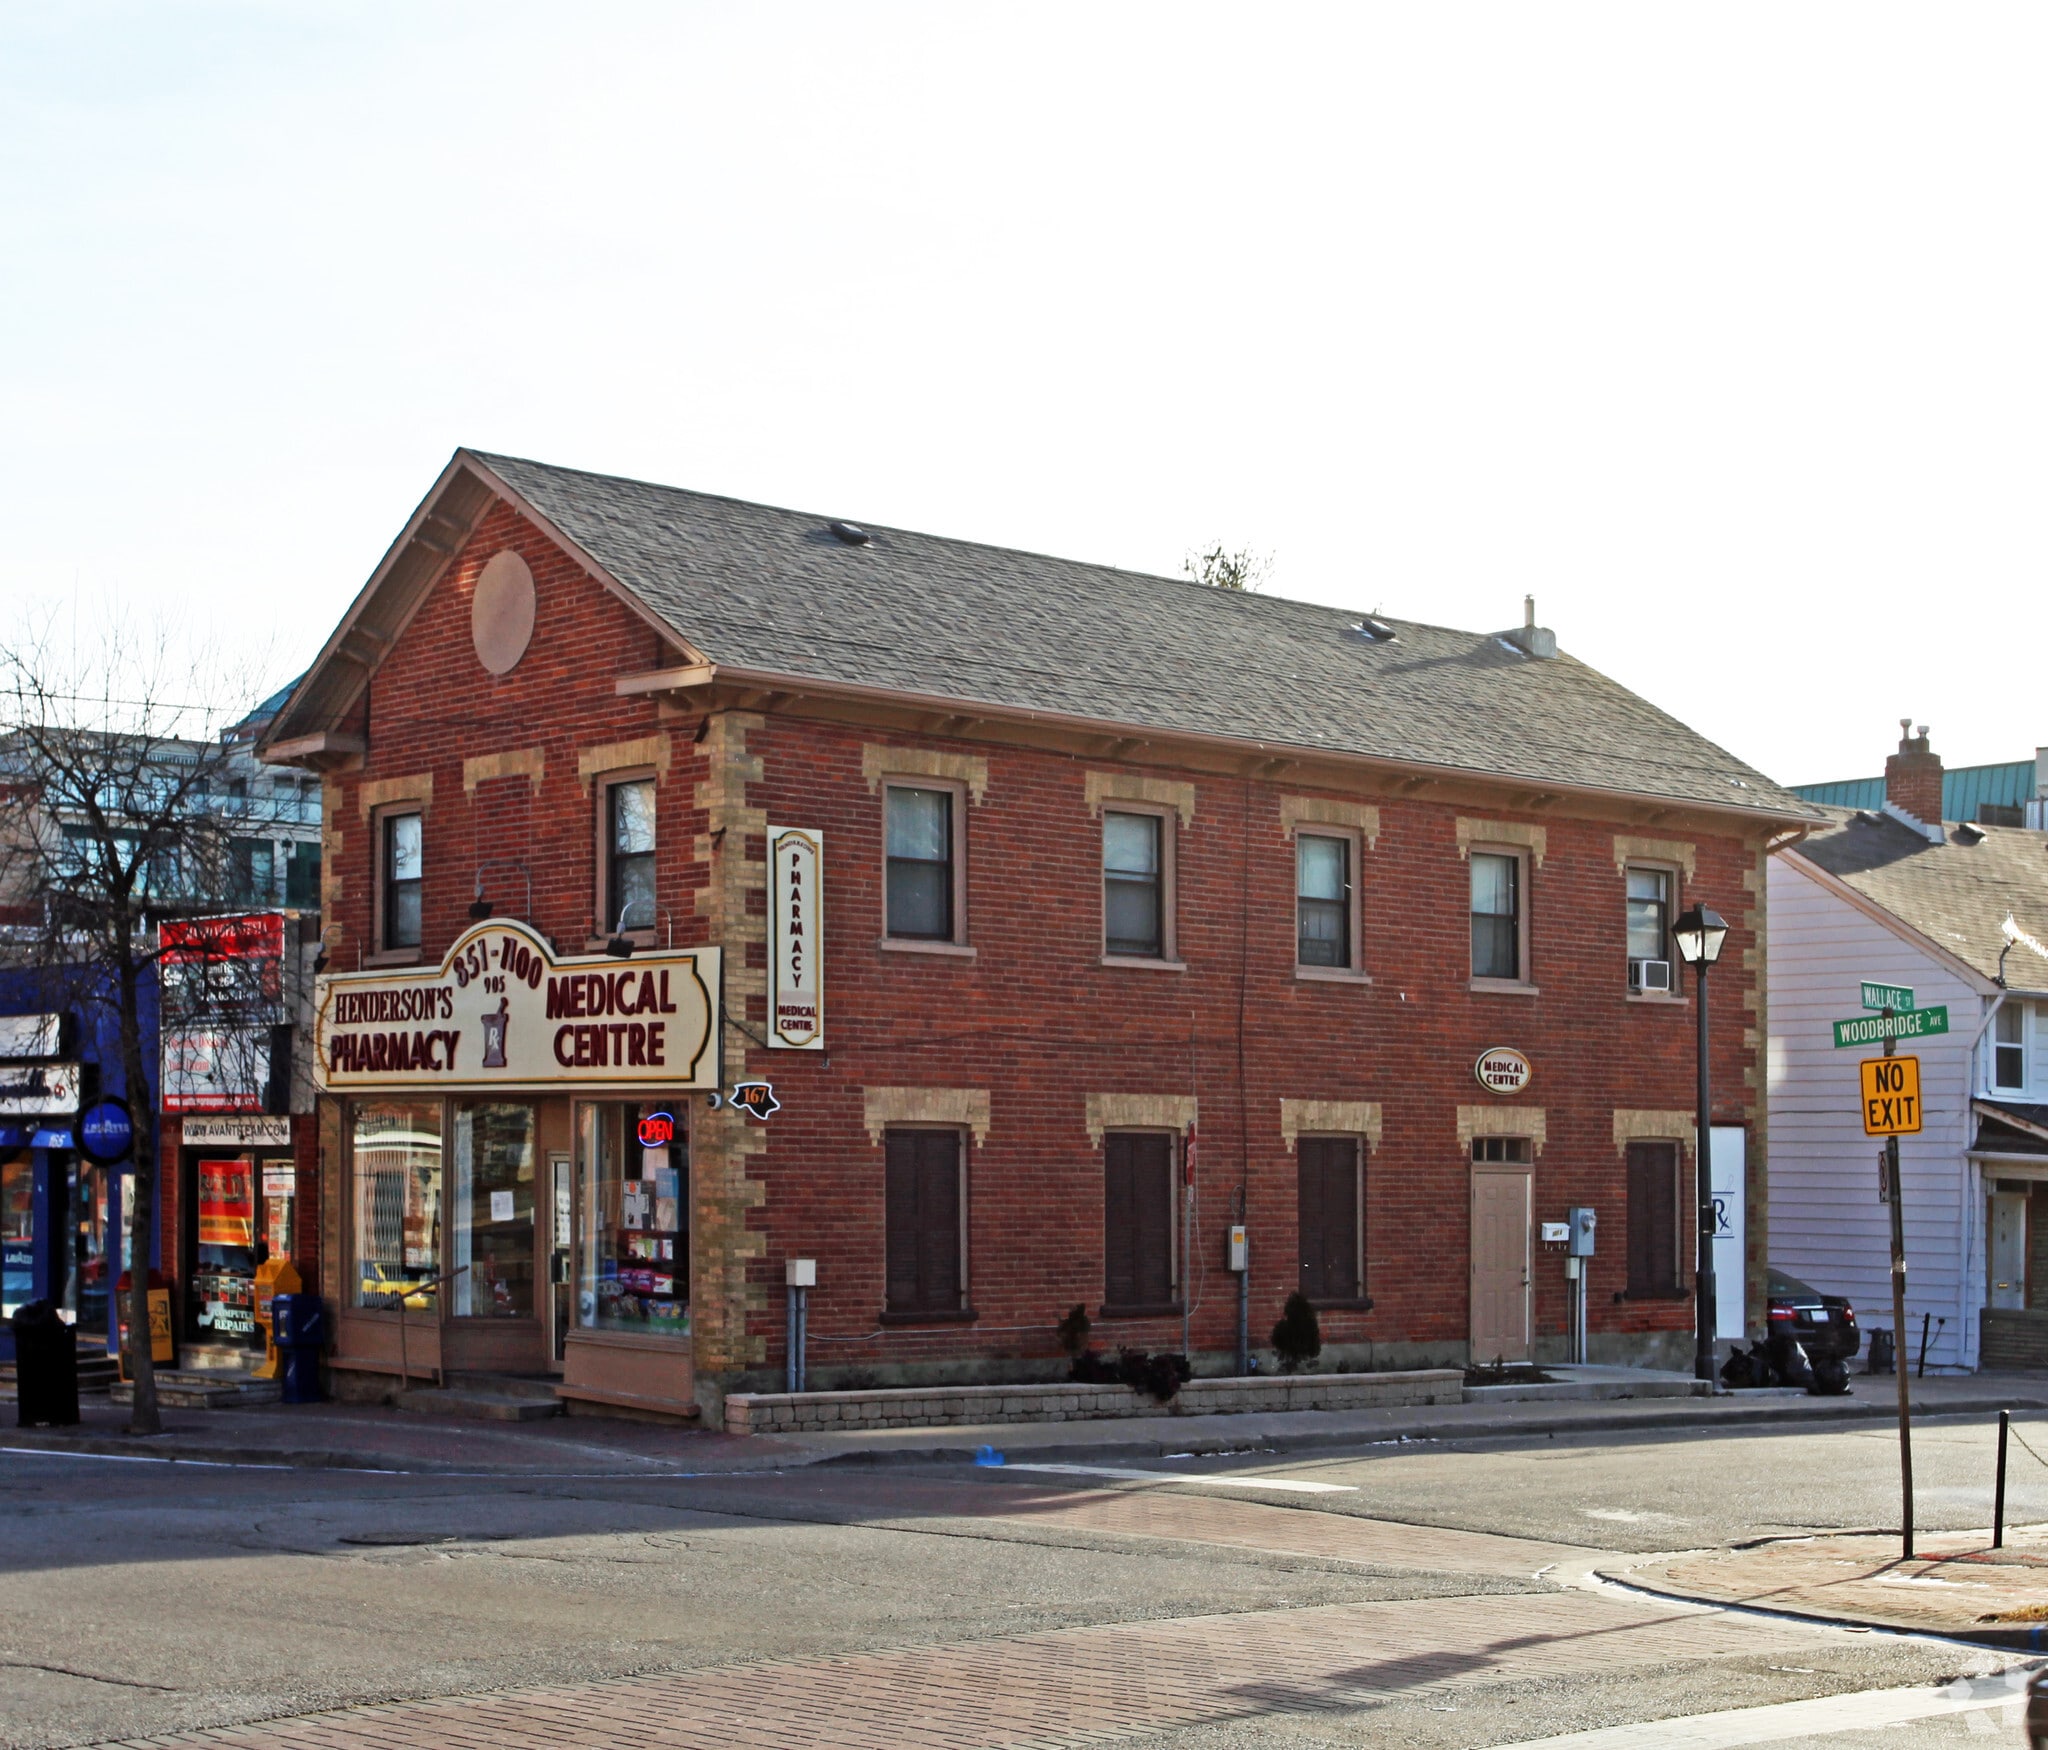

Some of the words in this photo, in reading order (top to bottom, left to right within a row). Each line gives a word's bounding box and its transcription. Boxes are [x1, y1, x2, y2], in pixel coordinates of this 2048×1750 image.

[790, 853, 803, 988] PHARMACY
[453, 936, 543, 990] 851-1100
[484, 975, 506, 994] 905
[546, 970, 677, 1019] MEDICAL
[334, 986, 453, 1024] HENDERSON'S
[778, 1005, 816, 1017] MEDICAL
[1863, 986, 1902, 1010] WALLACE
[781, 1018, 813, 1031] CENTRE
[1840, 1014, 1923, 1043] WOODBRIDGE
[1929, 1015, 1942, 1027] AVE
[331, 1030, 461, 1072] PHARMACY
[553, 1022, 665, 1067] CENTRE
[1484, 1060, 1524, 1074] MEDICAL
[1486, 1073, 1520, 1086] CENTRE
[1875, 1064, 1904, 1093] NO
[743, 1087, 767, 1104] 167
[1868, 1097, 1915, 1127] EXIT
[638, 1119, 673, 1141] OPEN
[214, 1319, 255, 1332] REPAIRS
